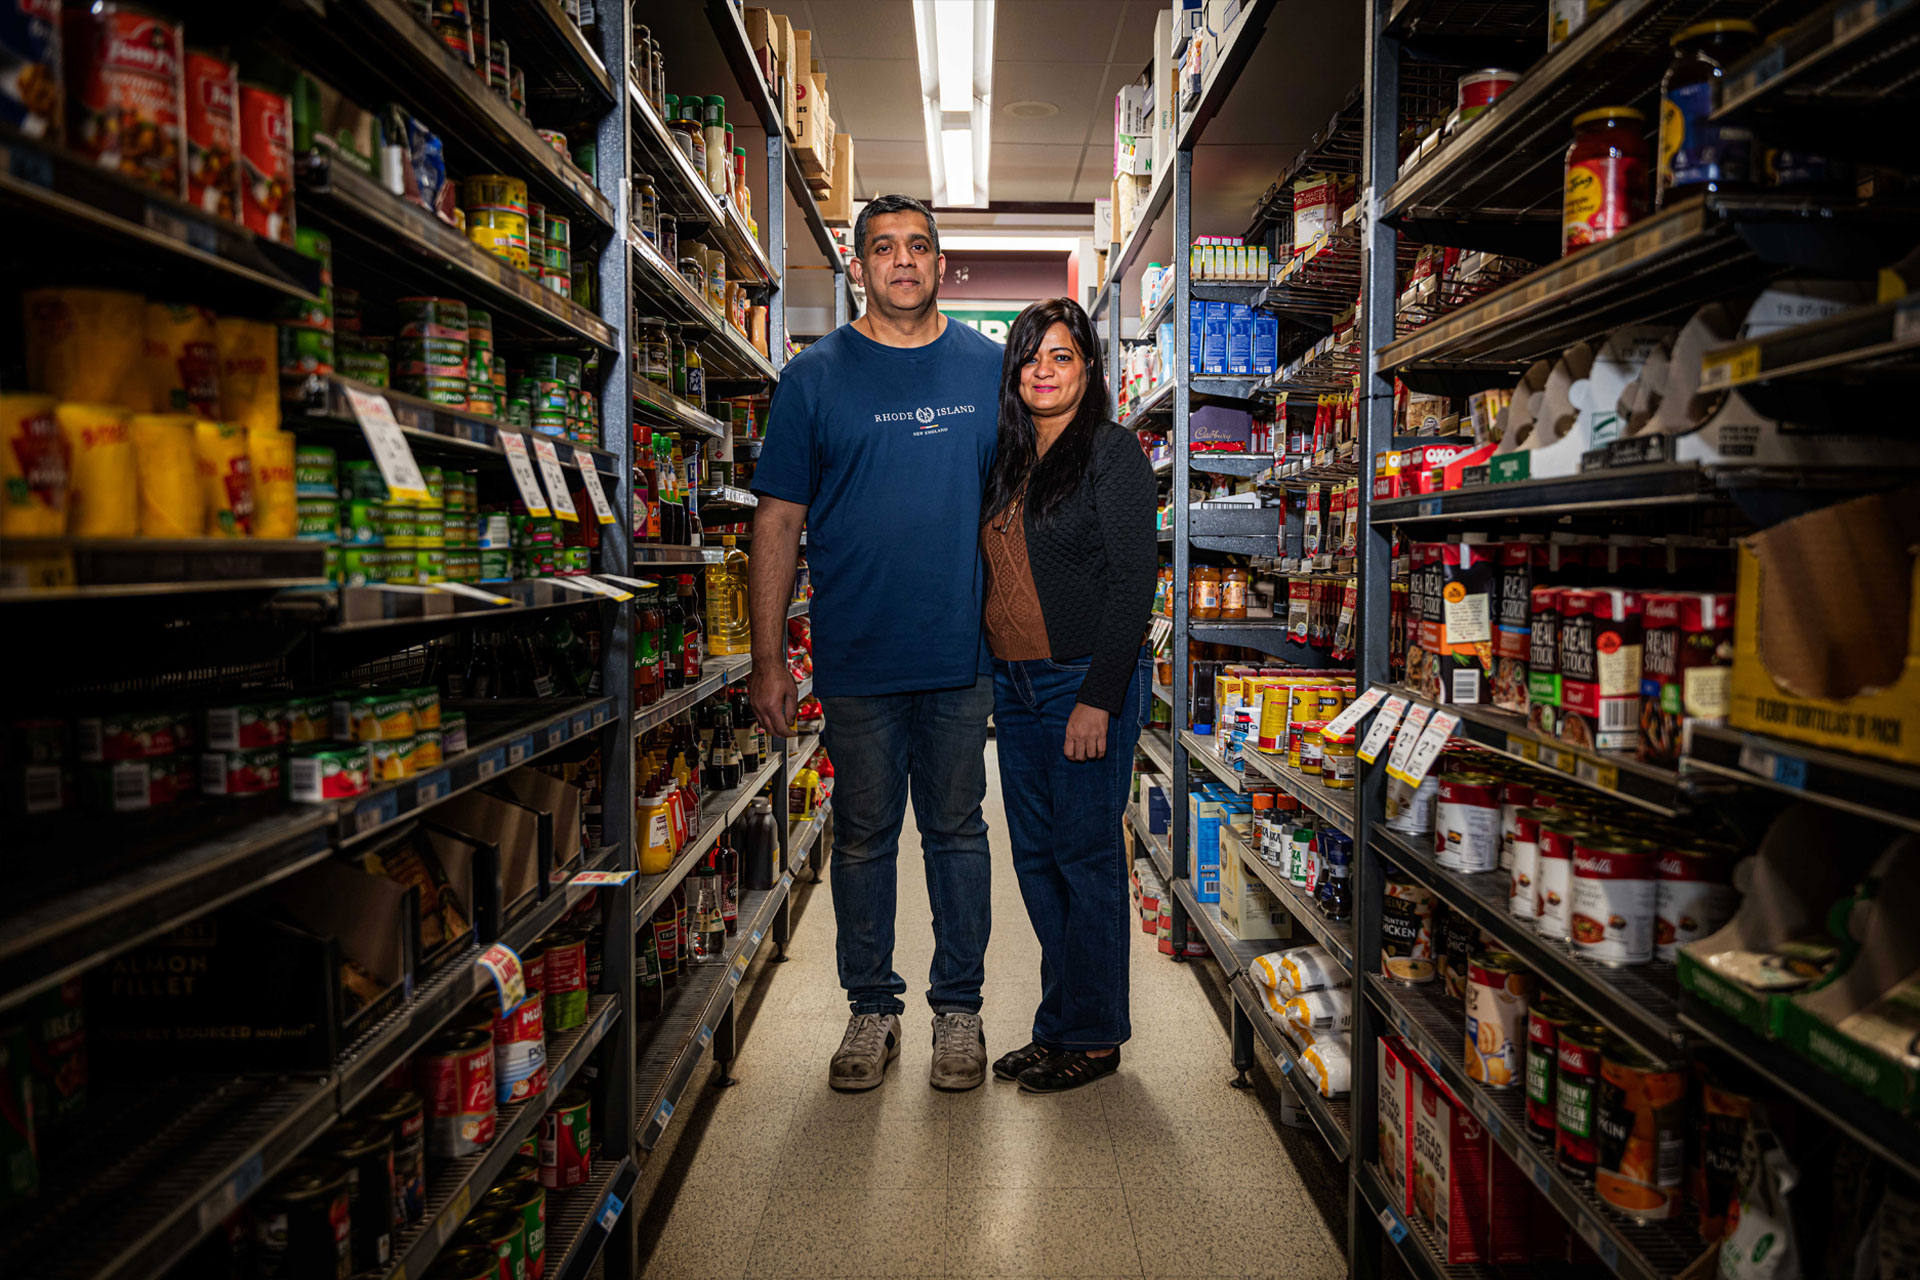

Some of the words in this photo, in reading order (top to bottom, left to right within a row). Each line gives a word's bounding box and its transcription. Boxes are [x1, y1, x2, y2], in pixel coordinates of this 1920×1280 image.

[874, 411, 914, 423] RHODE
[936, 404, 976, 417] ISLAND
[925, 427, 948, 435] ENGLAND
[1194, 426, 1232, 440] Cadbury
[1425, 448, 1456, 463] OXO
[1425, 572, 1442, 594] REAL
[1503, 575, 1530, 600] REAL
[1501, 599, 1529, 617] STOCK
[1530, 621, 1556, 646] REAL
[1562, 624, 1594, 652] REAL
[1646, 629, 1677, 653] REAL
[1529, 645, 1556, 665] STOCK
[1561, 650, 1594, 674] STOCK
[1644, 653, 1677, 675] STOCK
[110, 953, 208, 976] ALMON
[500, 958, 519, 984] LINE
[529, 1044, 544, 1059] PO
[1381, 1083, 1400, 1118] BREAD
[1379, 1099, 1403, 1139] CRUMBS
[1416, 1121, 1442, 1158] BREAD
[1414, 1136, 1446, 1182] CRUMBS
